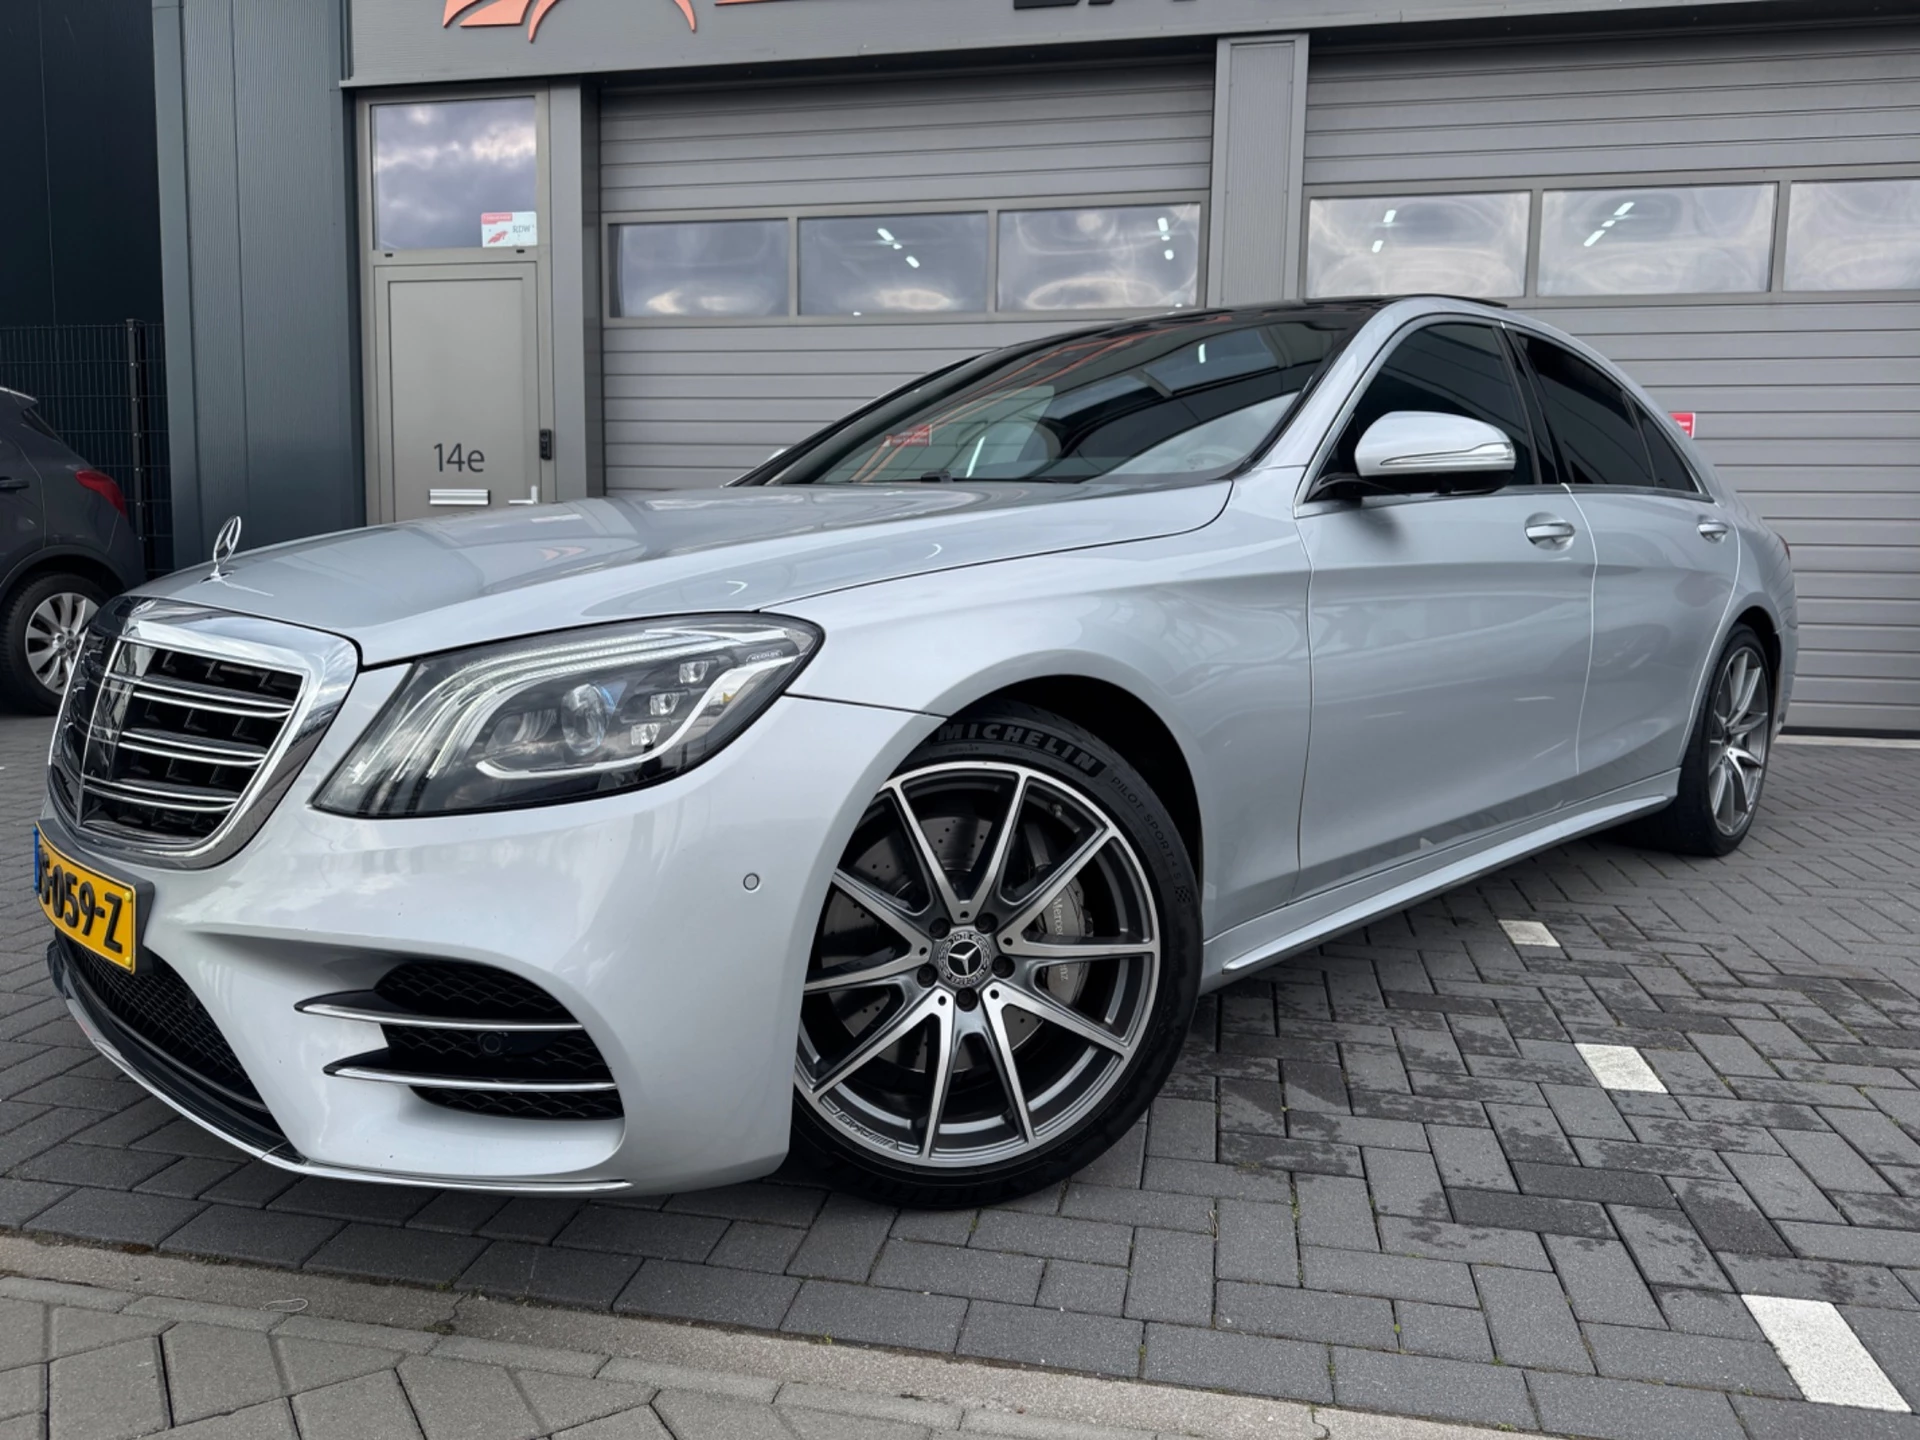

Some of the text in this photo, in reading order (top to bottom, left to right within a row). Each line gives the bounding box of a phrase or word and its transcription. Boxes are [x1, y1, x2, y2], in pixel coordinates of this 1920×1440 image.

[433, 442, 485, 473] 14e
[938, 723, 1097, 771] MICHELIN
[1110, 776, 1145, 809] PILOT
[1143, 813, 1175, 859] SPORT
